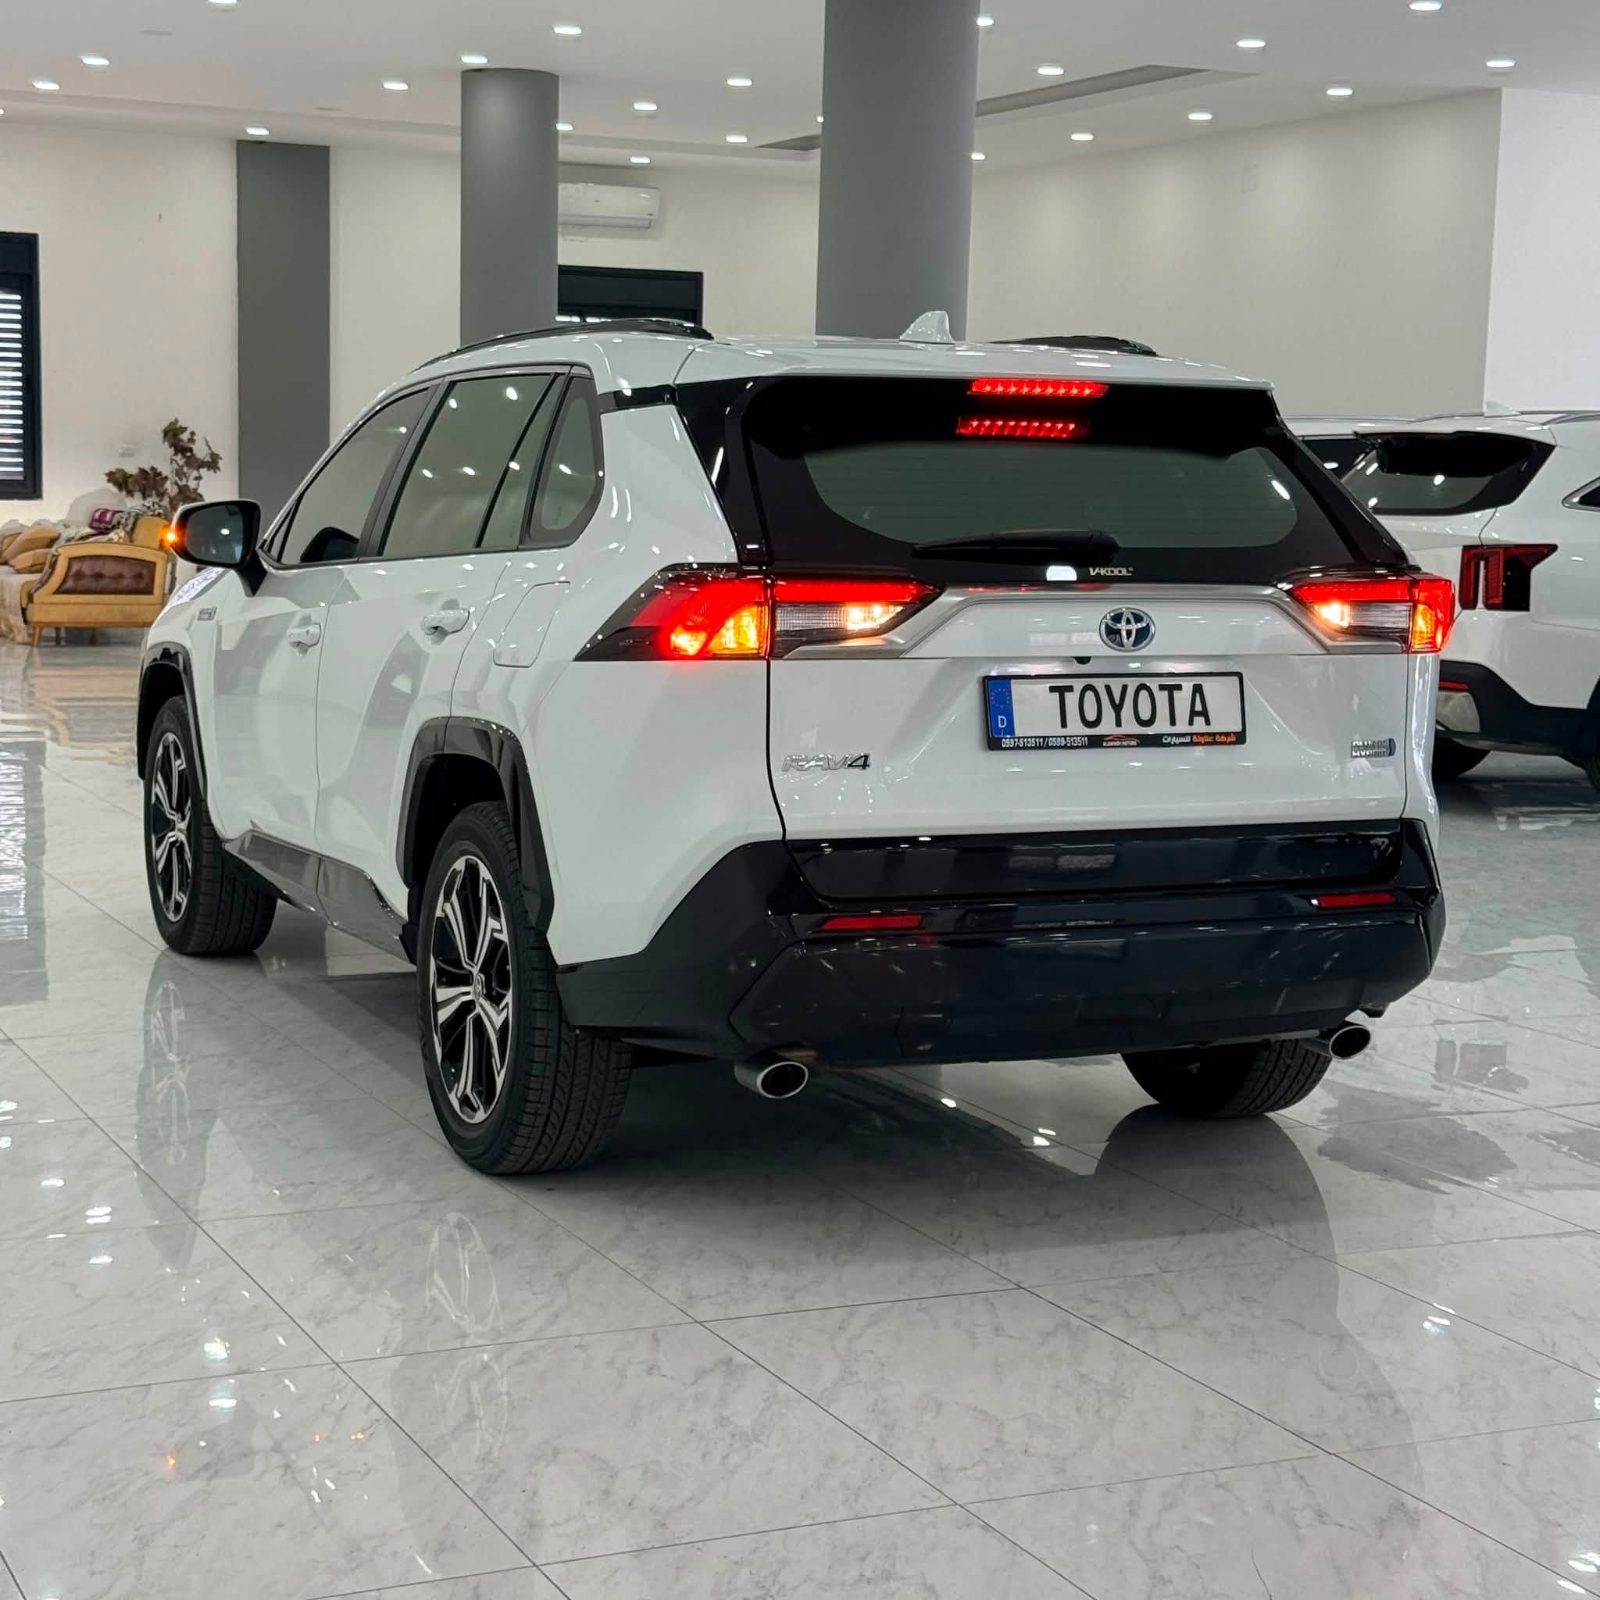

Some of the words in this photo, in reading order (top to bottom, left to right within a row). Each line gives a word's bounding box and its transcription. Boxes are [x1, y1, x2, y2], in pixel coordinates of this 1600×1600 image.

[1049, 683, 1211, 729] TOYOTA
[998, 716, 1007, 728] D
[781, 753, 871, 772] RAV4
